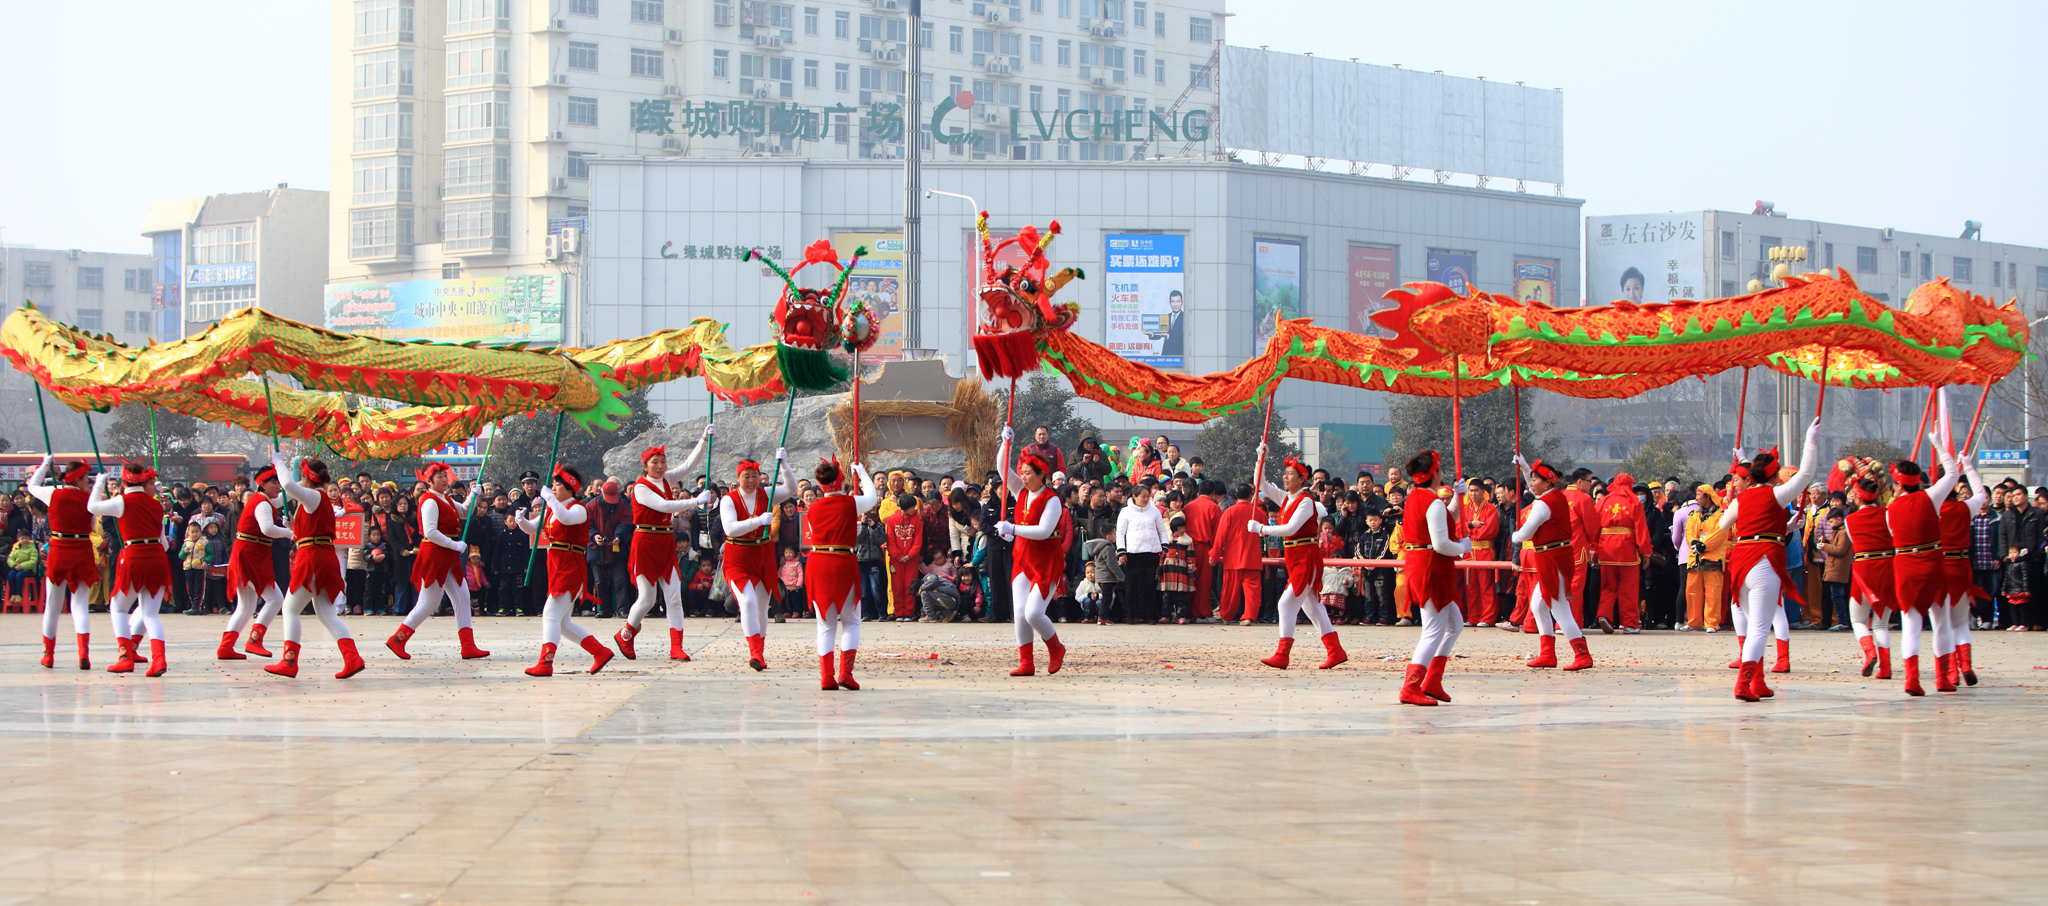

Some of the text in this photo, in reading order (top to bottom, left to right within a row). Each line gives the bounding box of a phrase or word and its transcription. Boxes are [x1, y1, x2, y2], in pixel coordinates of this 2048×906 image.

[635, 99, 904, 140] 绿城购物广场
[1010, 107, 1209, 142] LVCHENG
[1622, 220, 1696, 244] 左右沙发
